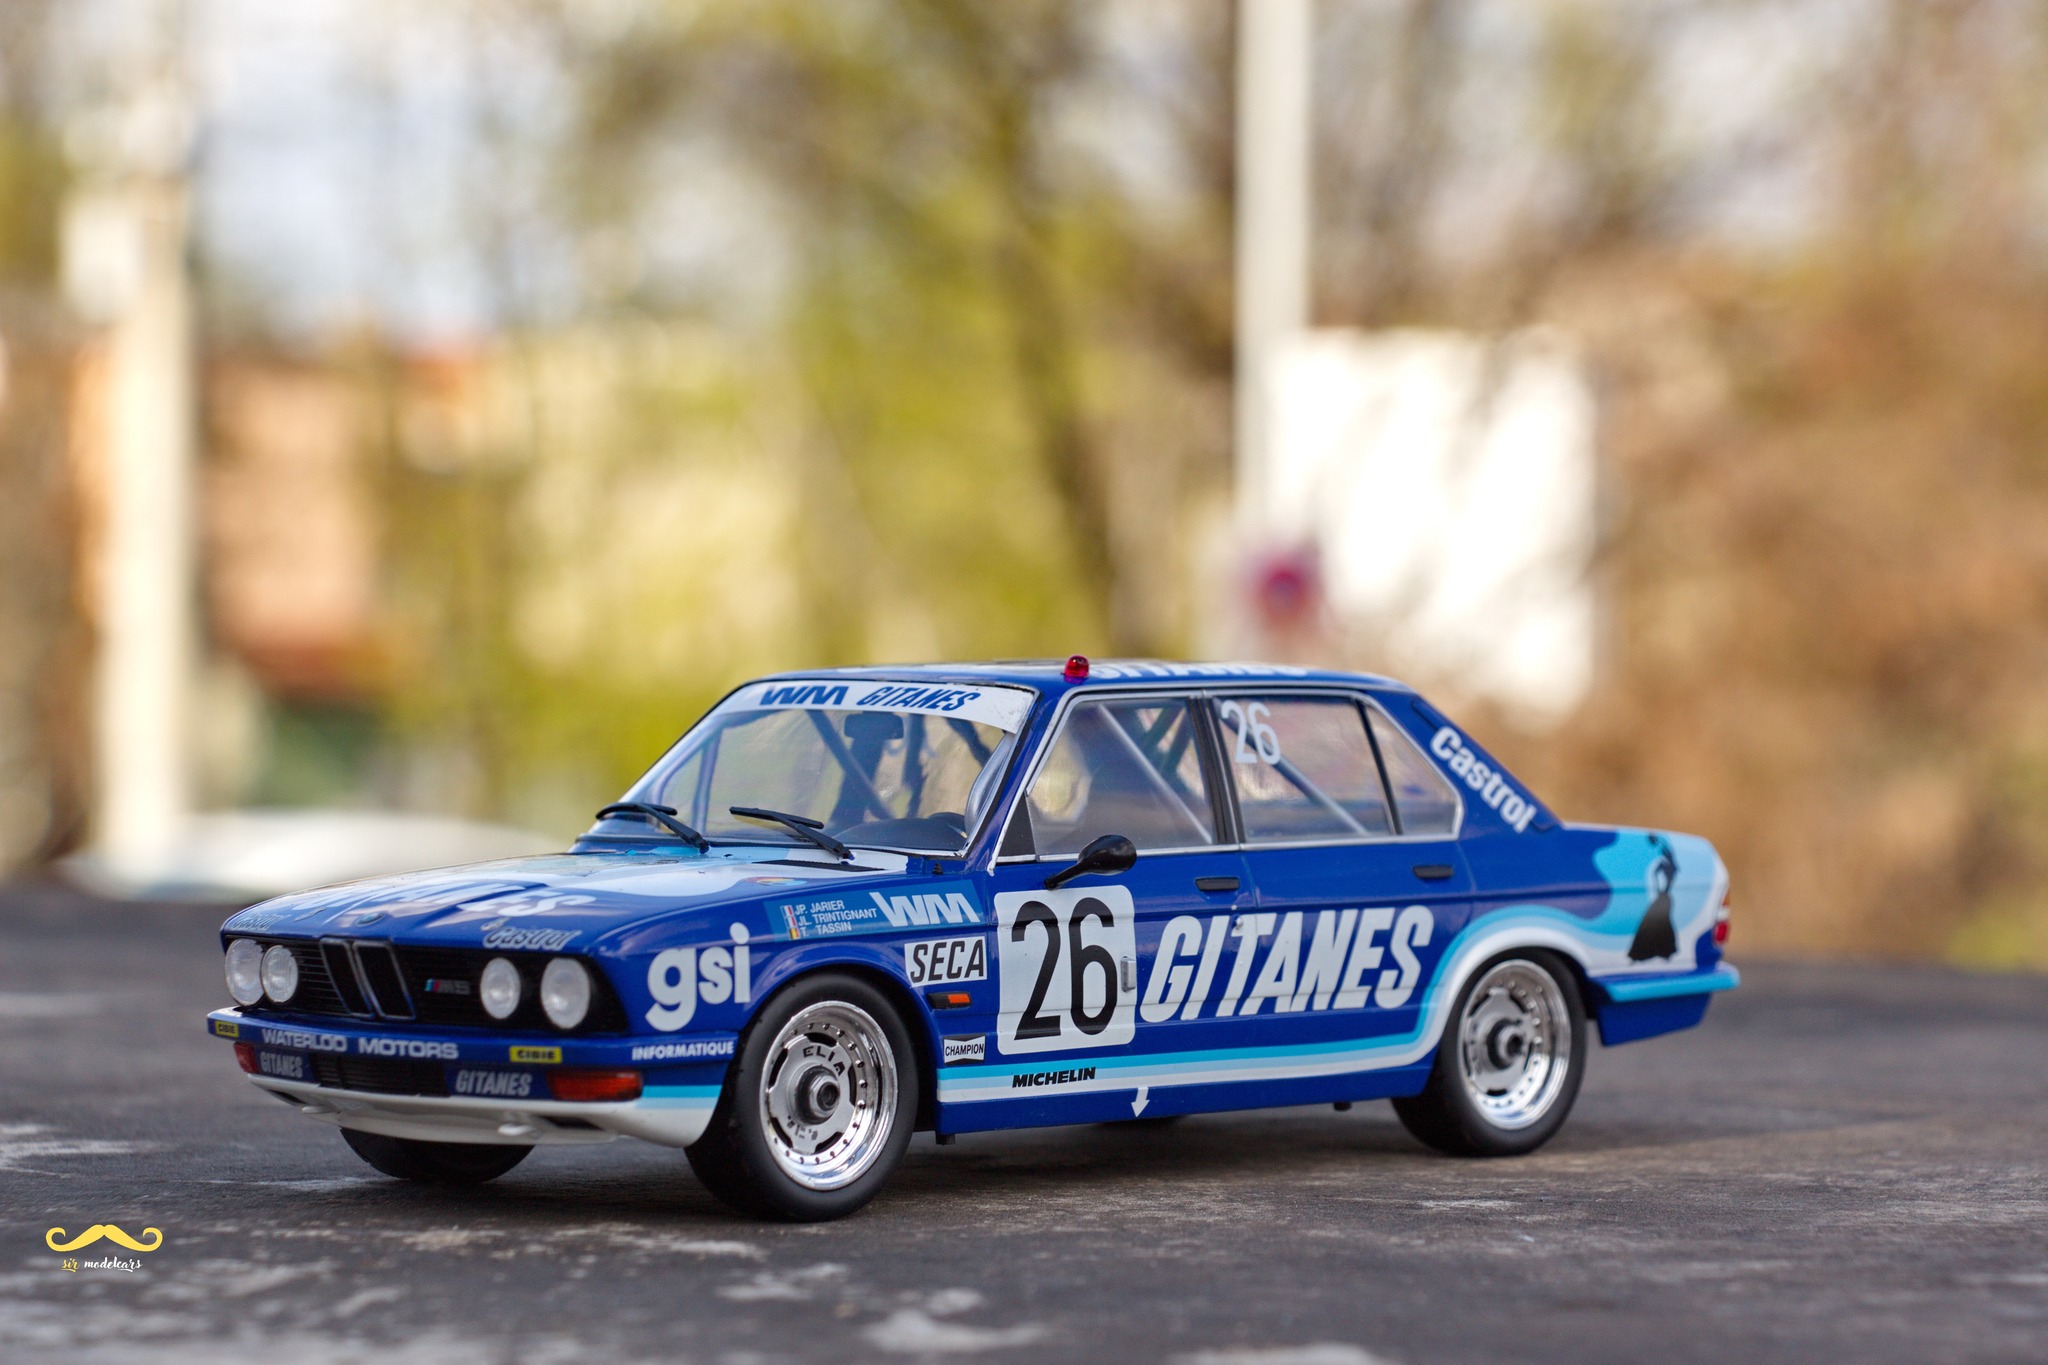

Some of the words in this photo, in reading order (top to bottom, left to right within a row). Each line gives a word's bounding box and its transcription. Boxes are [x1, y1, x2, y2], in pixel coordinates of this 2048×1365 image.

[760, 686, 849, 706] WM
[856, 686, 982, 711] GITANES
[1221, 700, 1281, 765] 26
[1430, 726, 1537, 834] Castrol
[810, 900, 845, 913] JARIER
[812, 908, 877, 924] TRINTIGNANT
[869, 892, 980, 927] WM
[483, 926, 582, 950] Castrol
[816, 922, 852, 935] TASSIN
[910, 939, 984, 983] SECA
[1012, 898, 1117, 1040] 26
[1139, 905, 1434, 1023] GITANES
[645, 922, 750, 1032] gsi
[262, 1028, 347, 1051] WATERLOO
[358, 1037, 459, 1060] MOTORS
[631, 1041, 735, 1061] INFORMATIQUE
[945, 1043, 984, 1057] CHAMPION
[259, 1051, 303, 1079] GITANES
[1012, 1067, 1096, 1088] MICHELIN
[455, 1070, 533, 1097] GITANES
